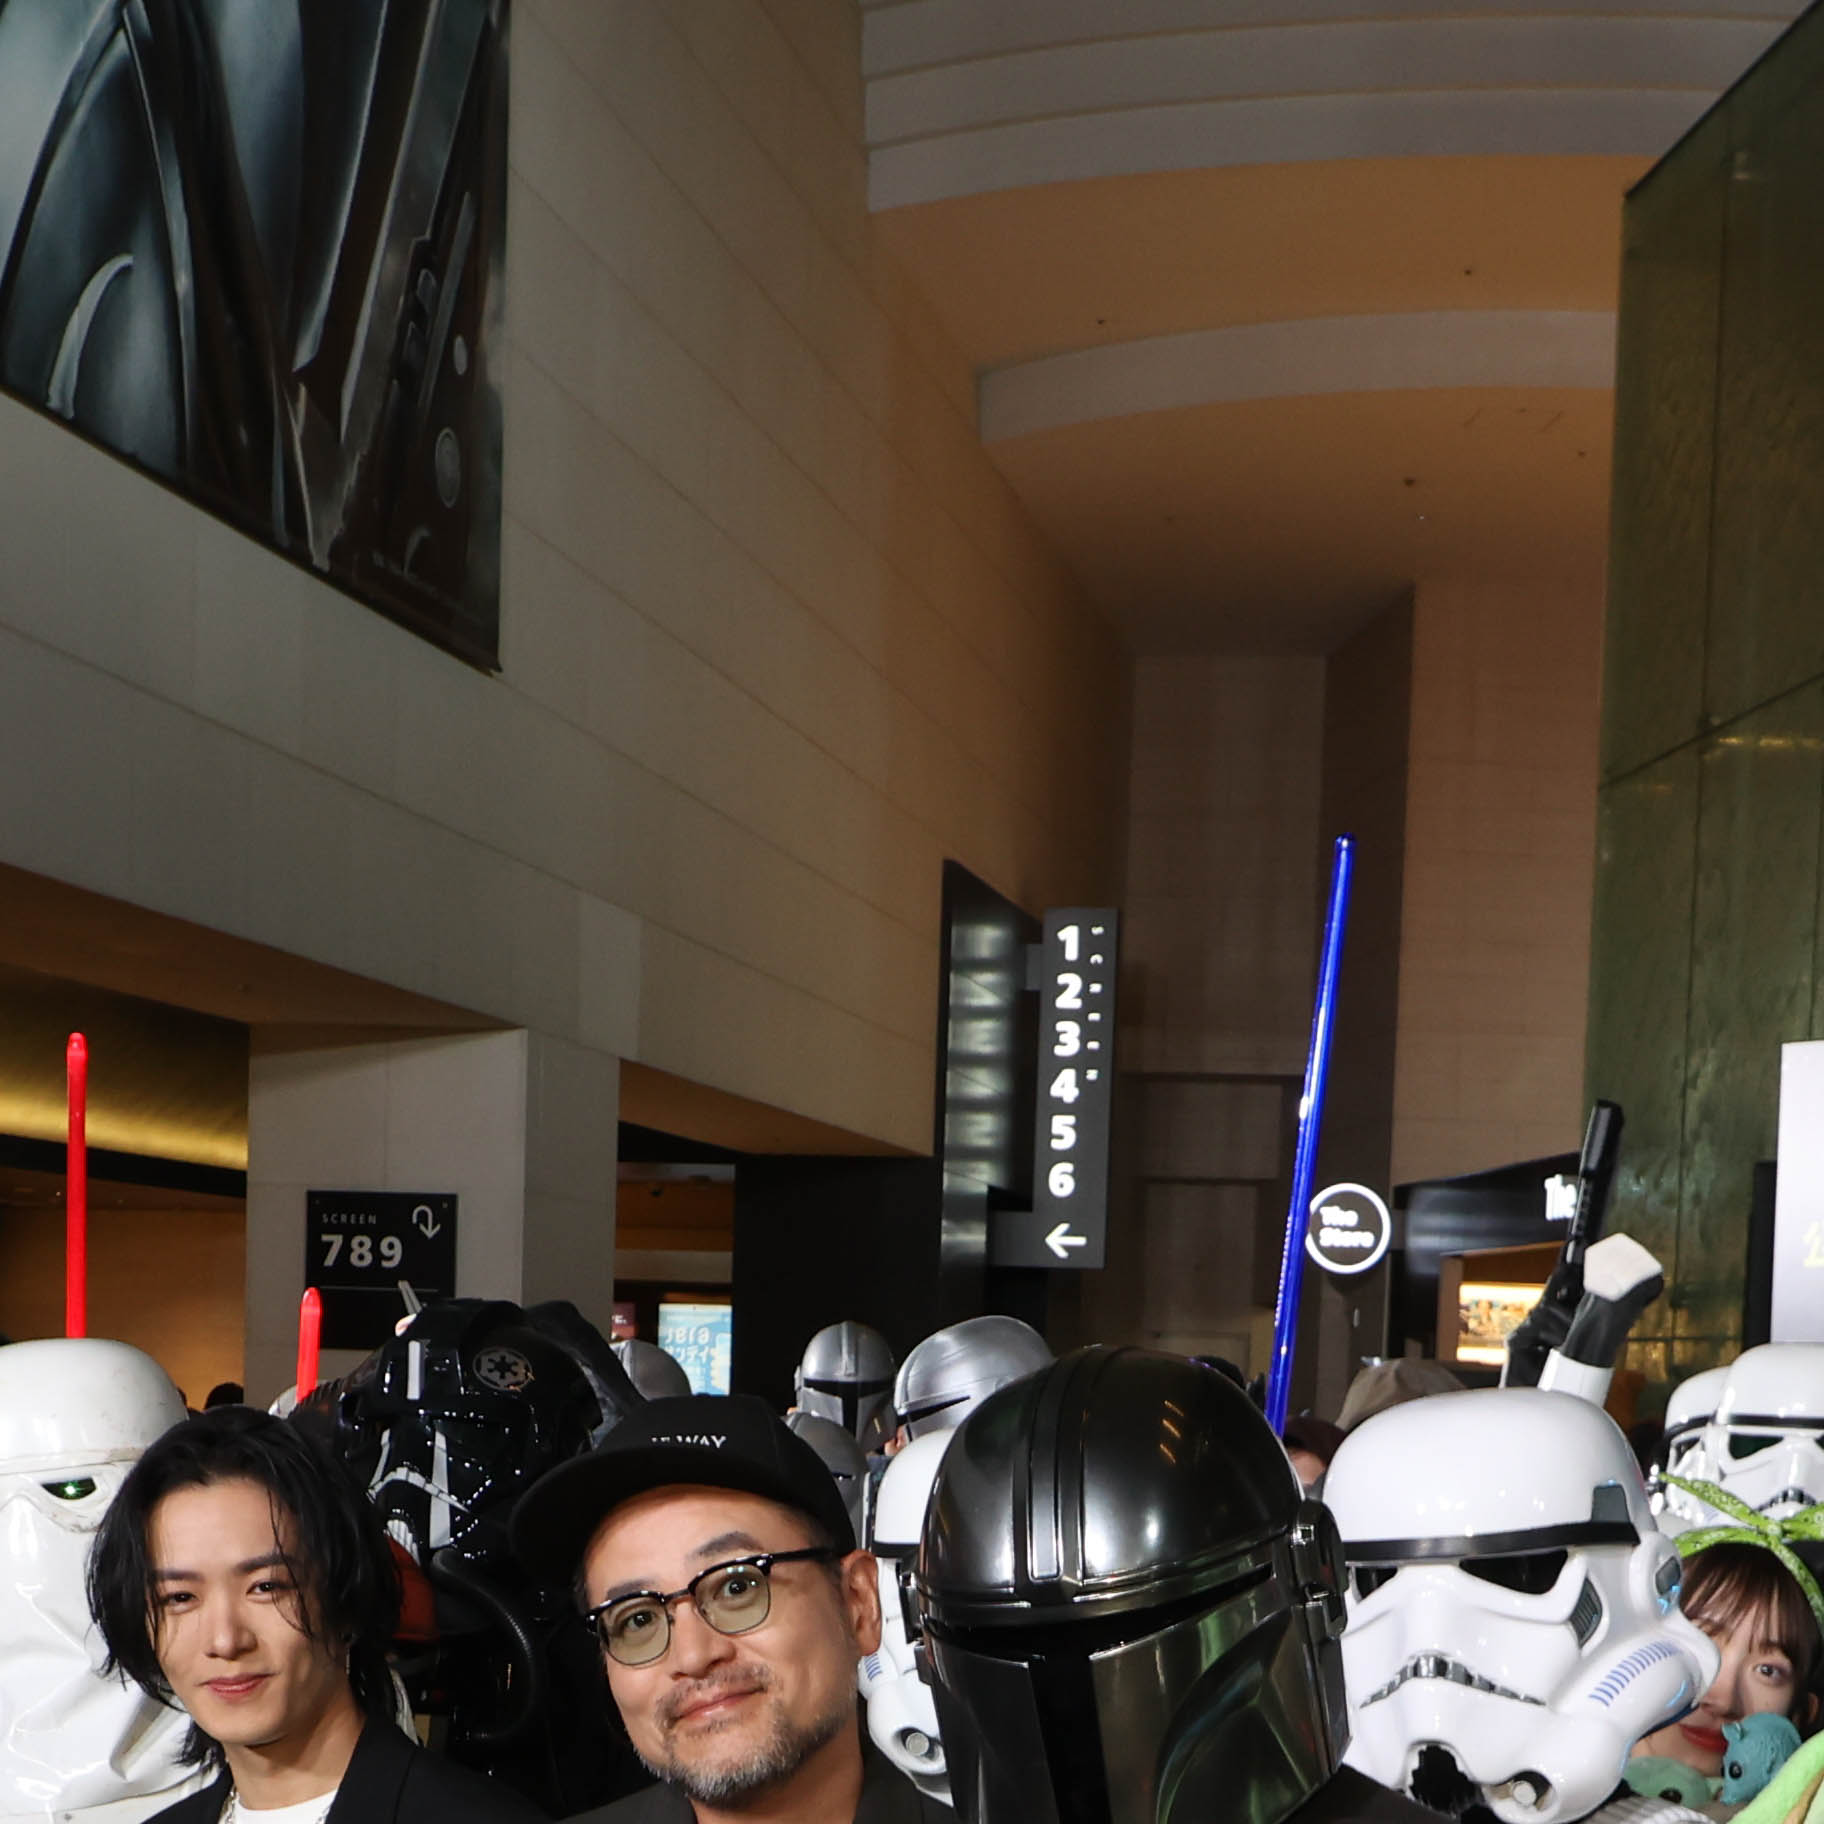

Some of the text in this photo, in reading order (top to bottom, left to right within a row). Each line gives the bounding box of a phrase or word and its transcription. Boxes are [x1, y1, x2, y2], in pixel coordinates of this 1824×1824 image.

[1048, 925, 1082, 1198] 1 2 3 4 5 6
[322, 1213, 376, 1225] SCREEN
[1319, 1205, 1359, 1227] The
[1319, 1226, 1375, 1248] Store
